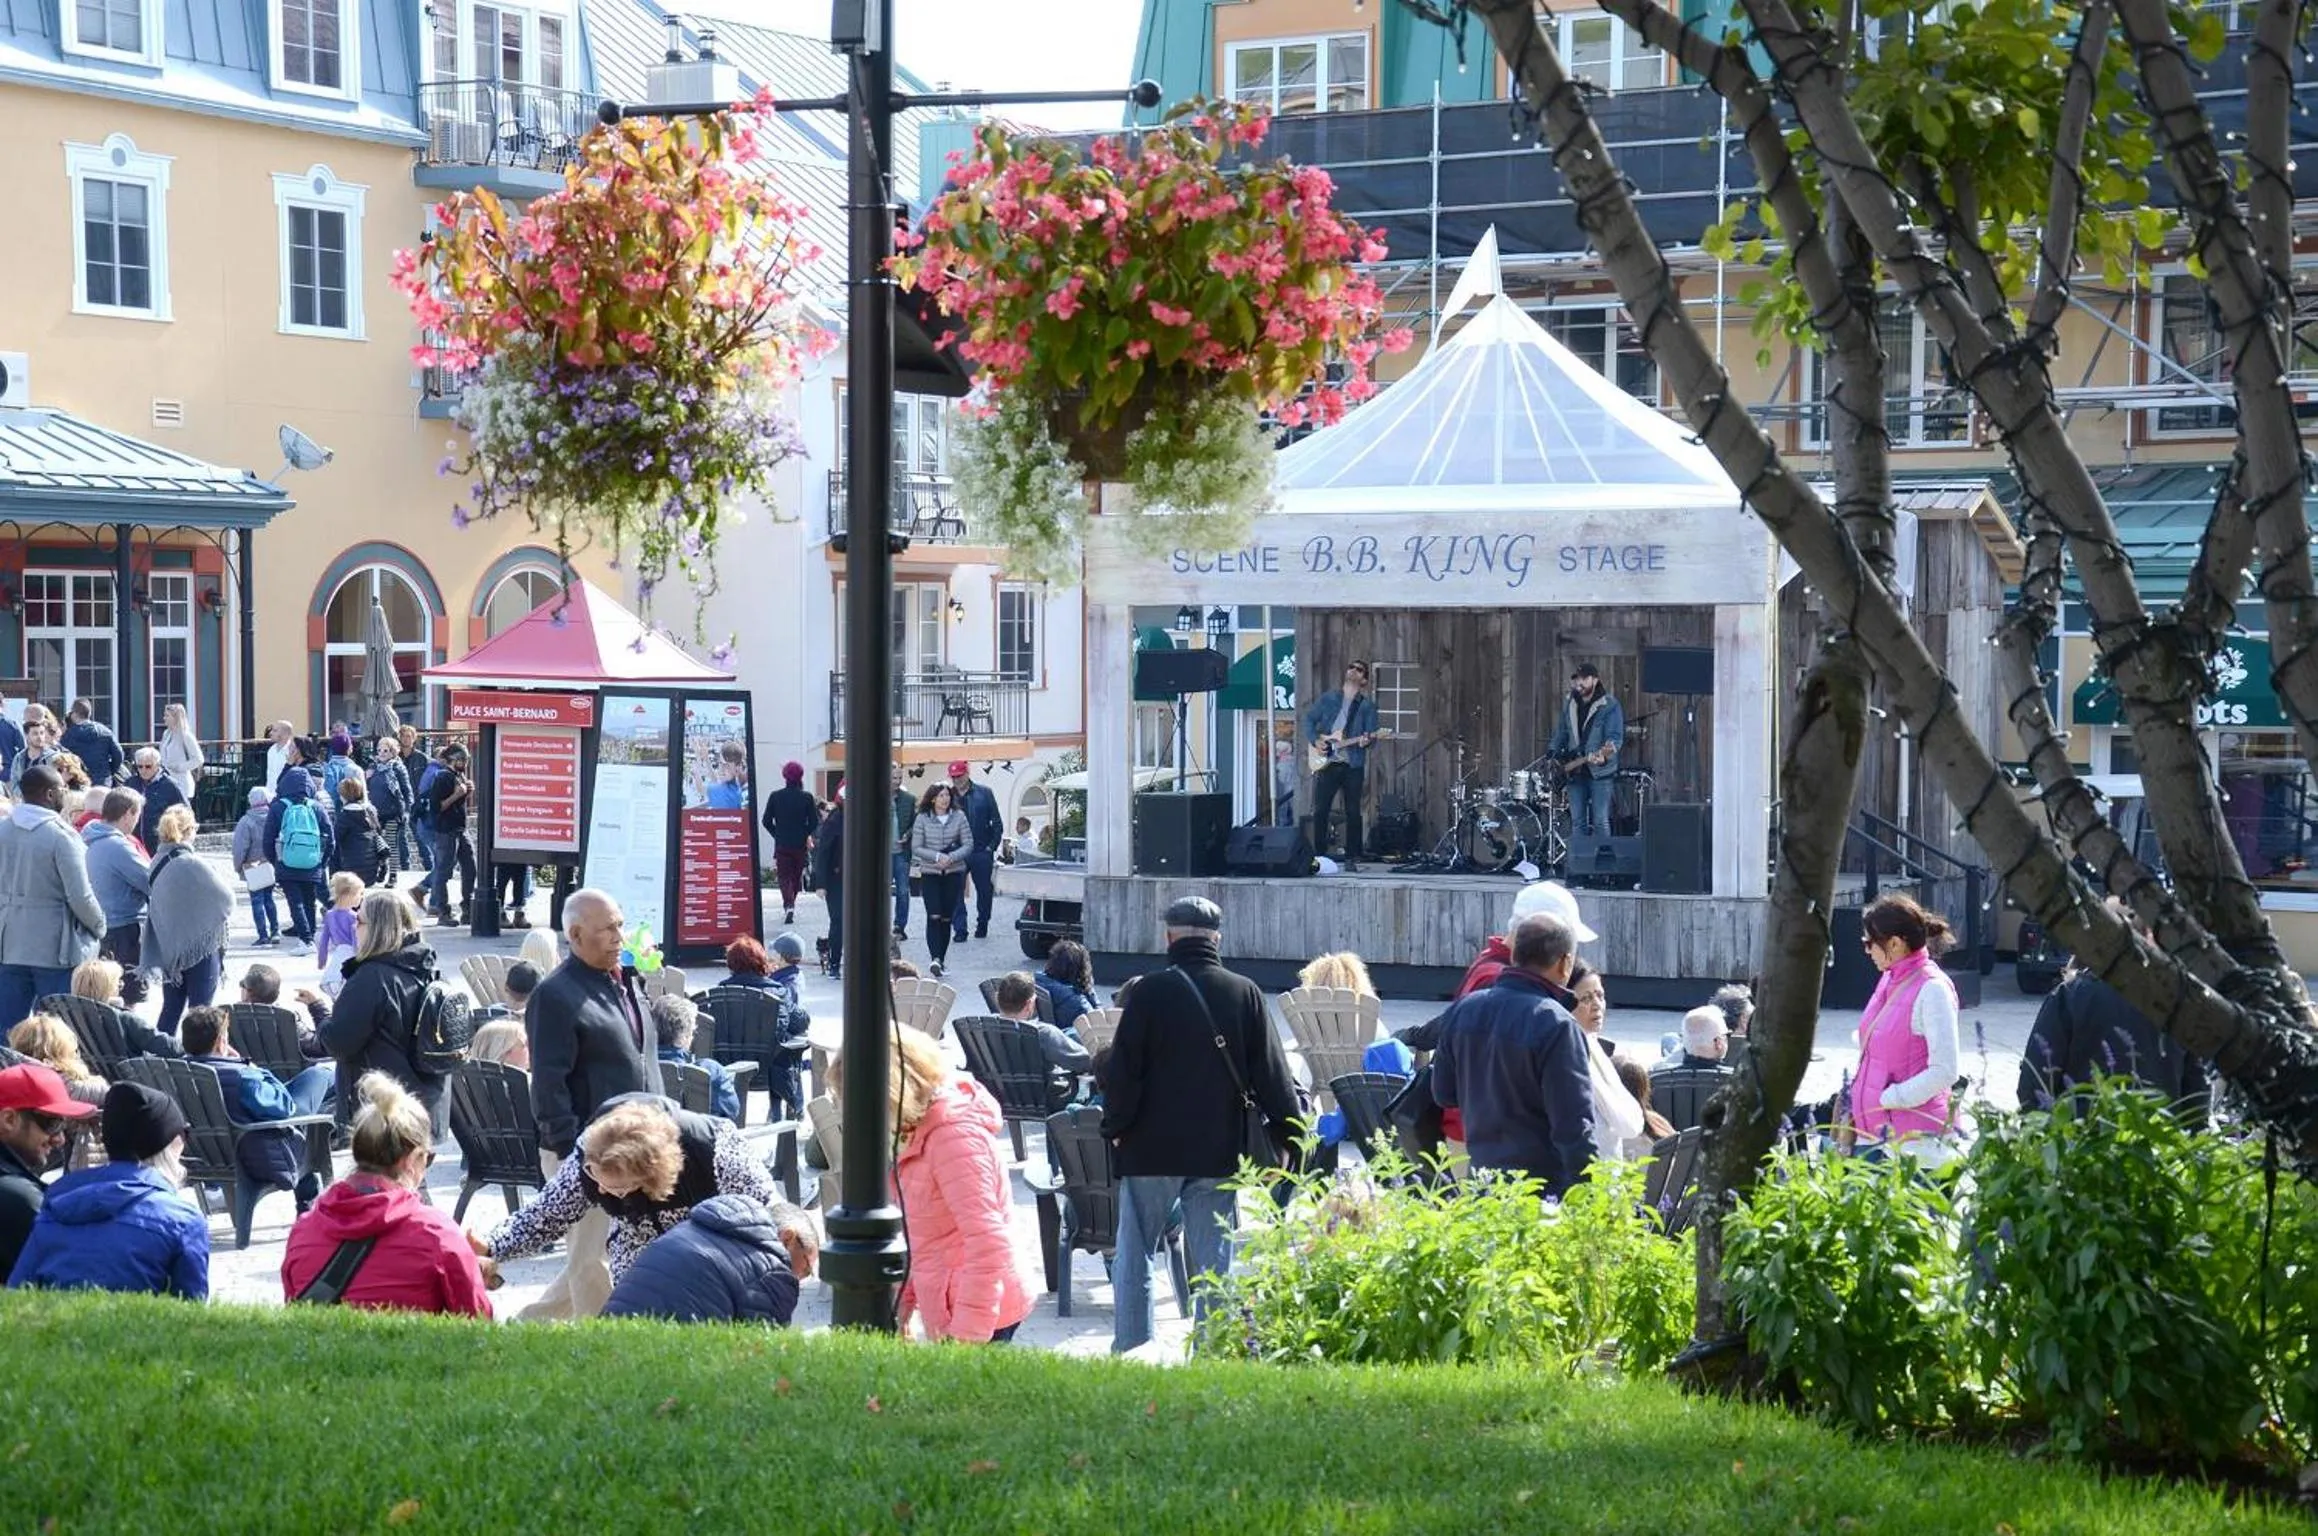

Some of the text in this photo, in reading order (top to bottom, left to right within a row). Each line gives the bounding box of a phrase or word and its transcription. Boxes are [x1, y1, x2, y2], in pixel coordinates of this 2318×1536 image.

[1172, 533, 1666, 588] SCENE B.B. KING STAGE
[453, 705, 558, 720] PLACE SAINT-BERNARD
